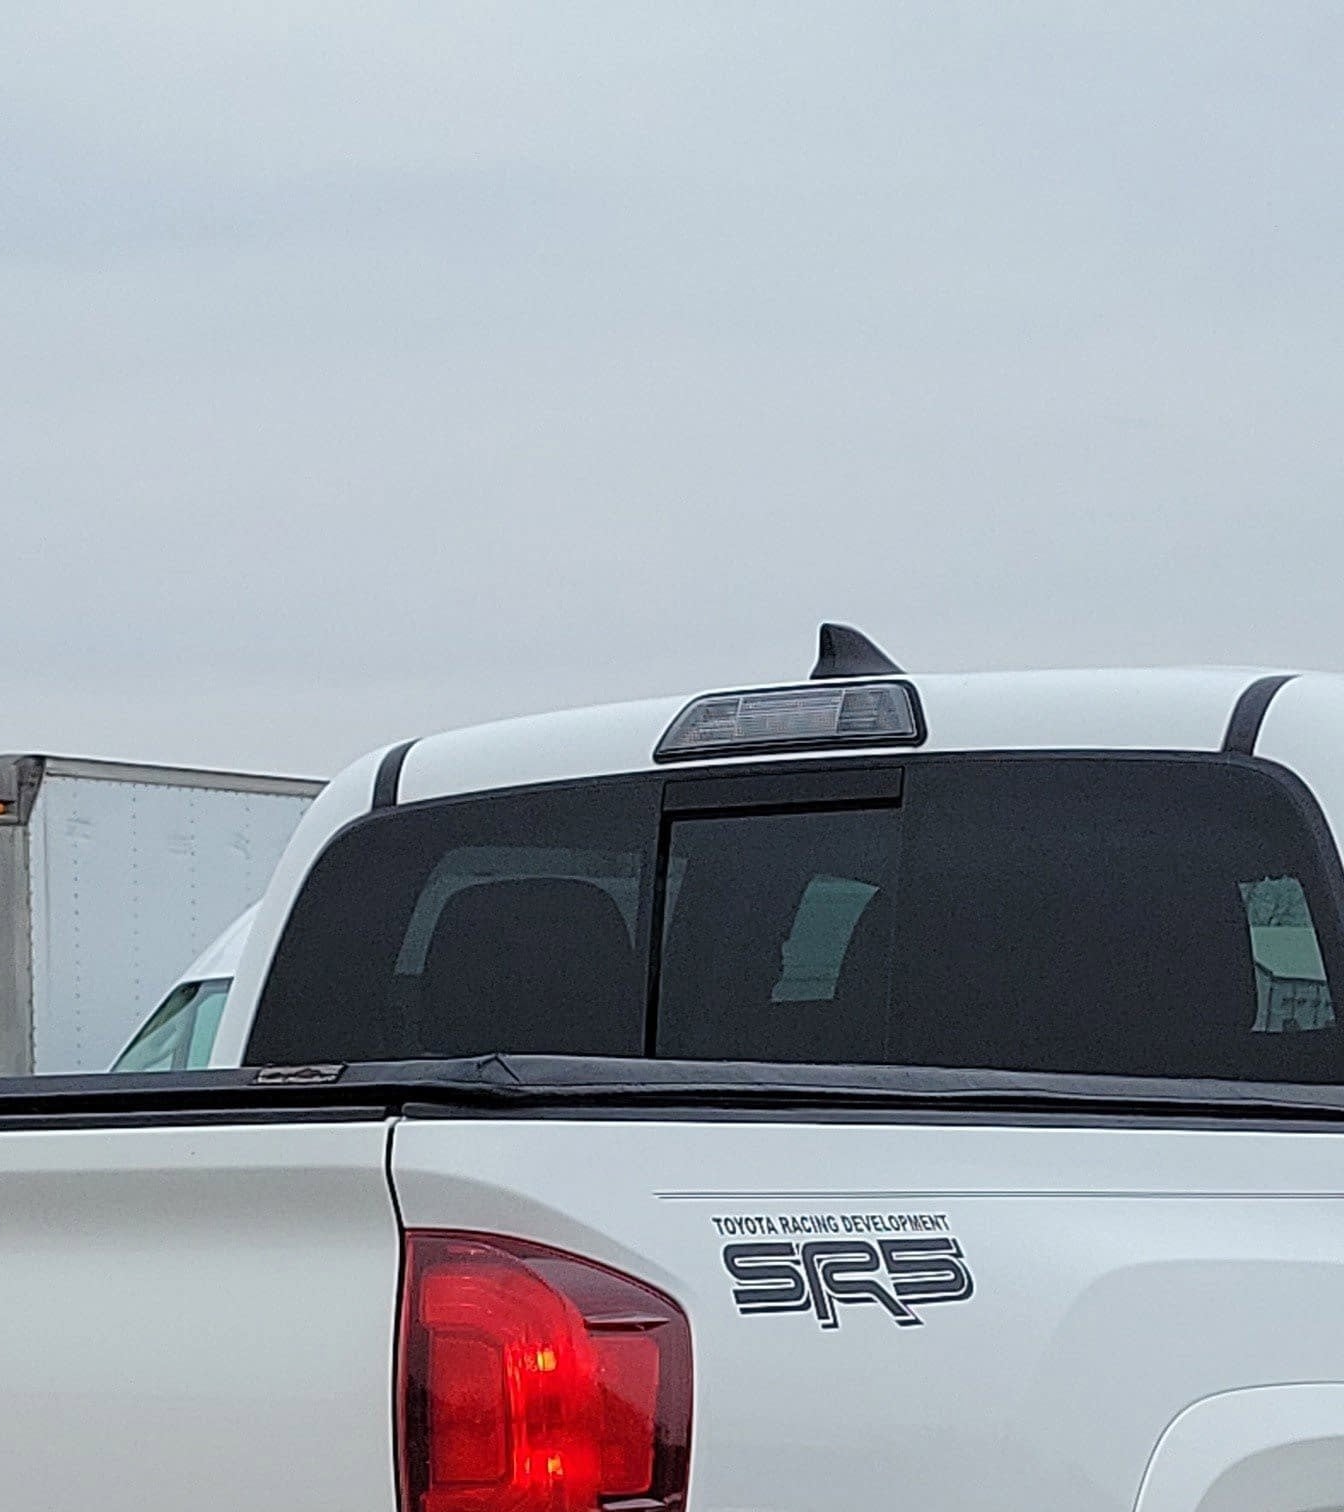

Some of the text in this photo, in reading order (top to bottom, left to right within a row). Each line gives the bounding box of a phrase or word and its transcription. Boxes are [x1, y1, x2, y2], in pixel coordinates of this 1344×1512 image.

[712, 1214, 950, 1236] TOYOTA RACING DEVELOPMENT
[723, 1237, 974, 1329] SR5
